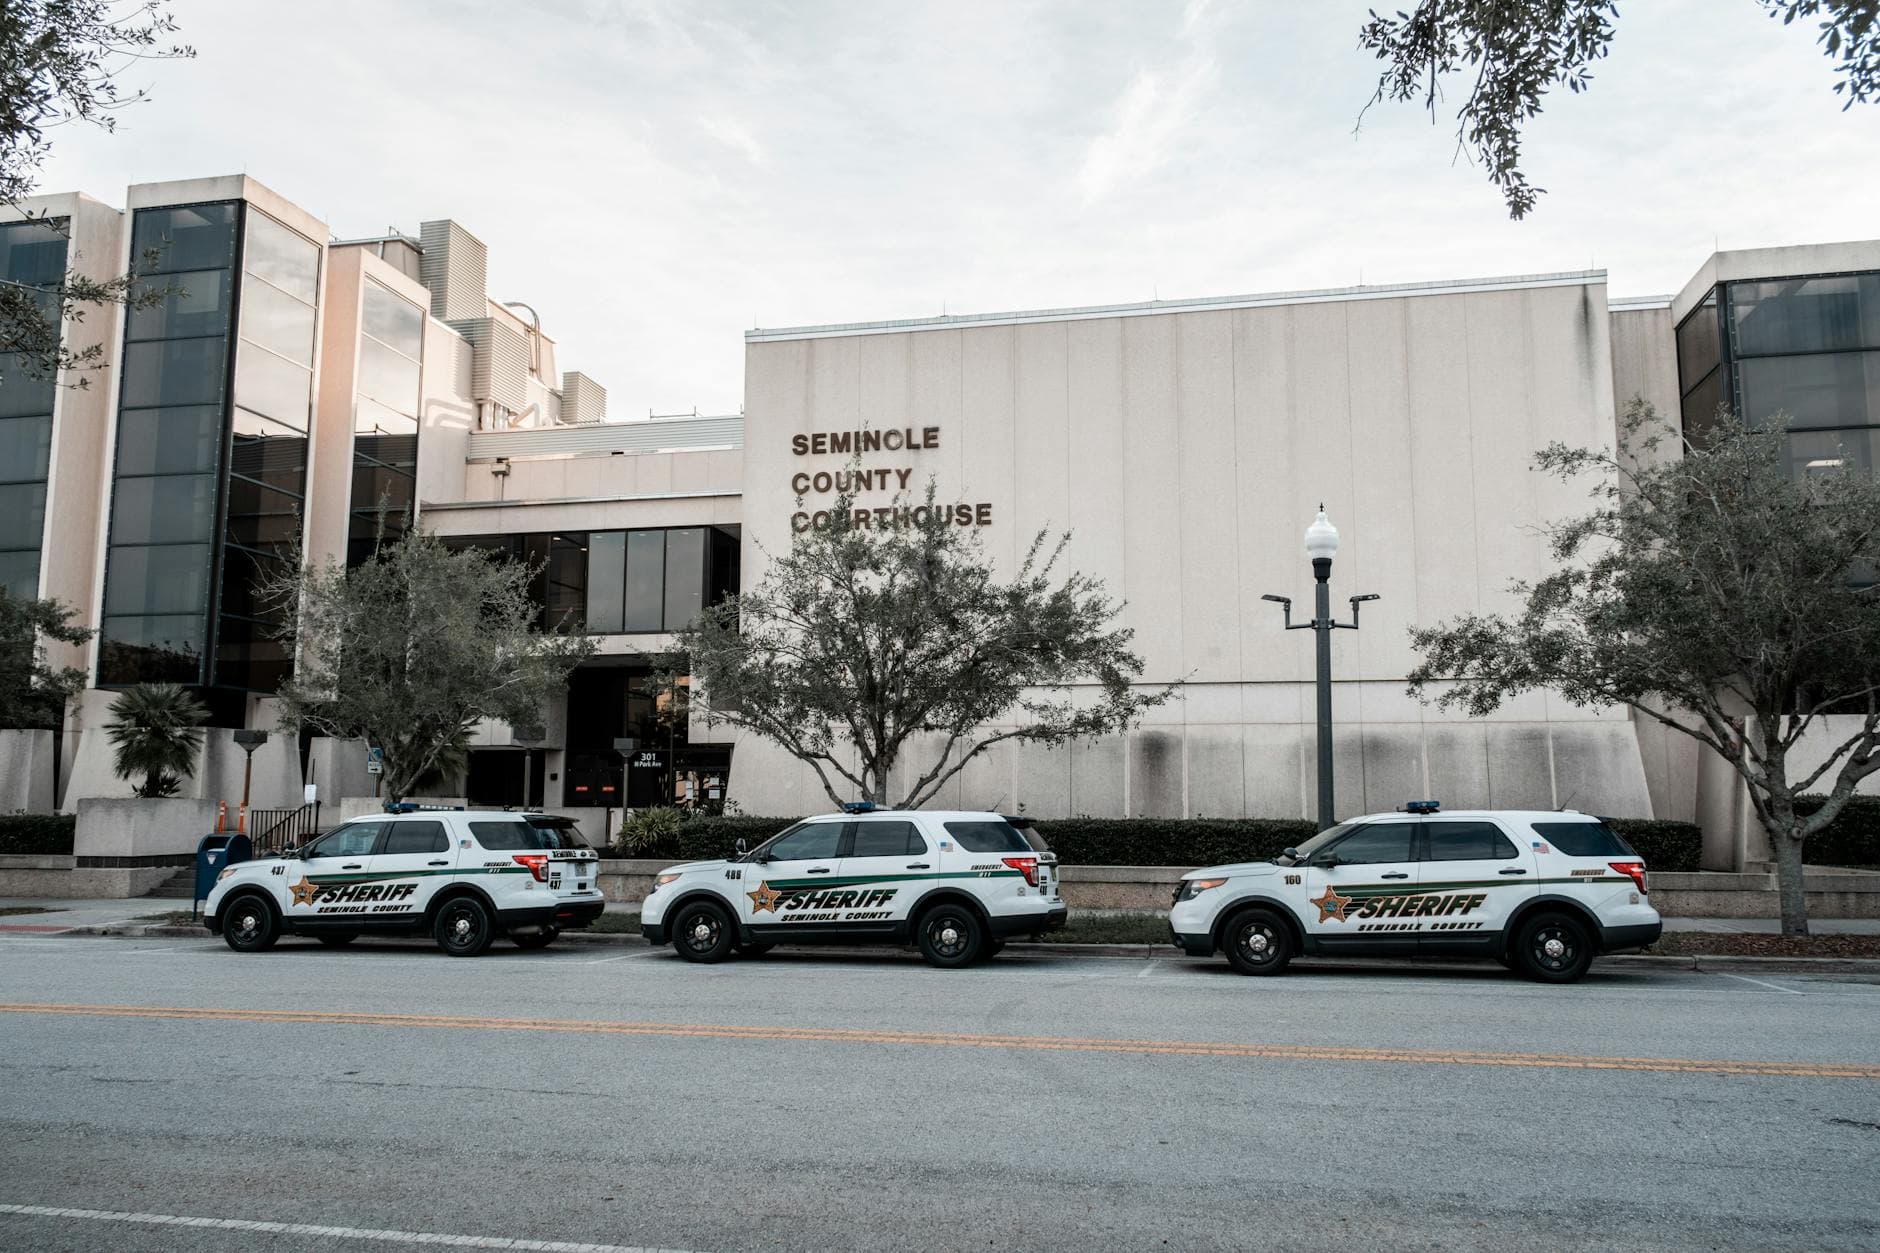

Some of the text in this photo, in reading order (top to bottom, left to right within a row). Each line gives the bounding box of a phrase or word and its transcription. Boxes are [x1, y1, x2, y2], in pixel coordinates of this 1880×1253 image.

[792, 426, 939, 456] SEMINOLE
[792, 468, 912, 495] COUNTY
[791, 503, 992, 533] CORTHOUSE
[641, 752, 656, 761] 301
[1284, 875, 1301, 885] 160
[321, 883, 419, 904] SHERIFF
[785, 888, 899, 911] SHERIFF
[317, 904, 414, 914] SEMINOLE COUNTY
[781, 911, 893, 922] SEMINOLE COUNTY
[1358, 894, 1488, 919] SHERIFF
[1358, 922, 1483, 932] SEMINOLE COUNTY
